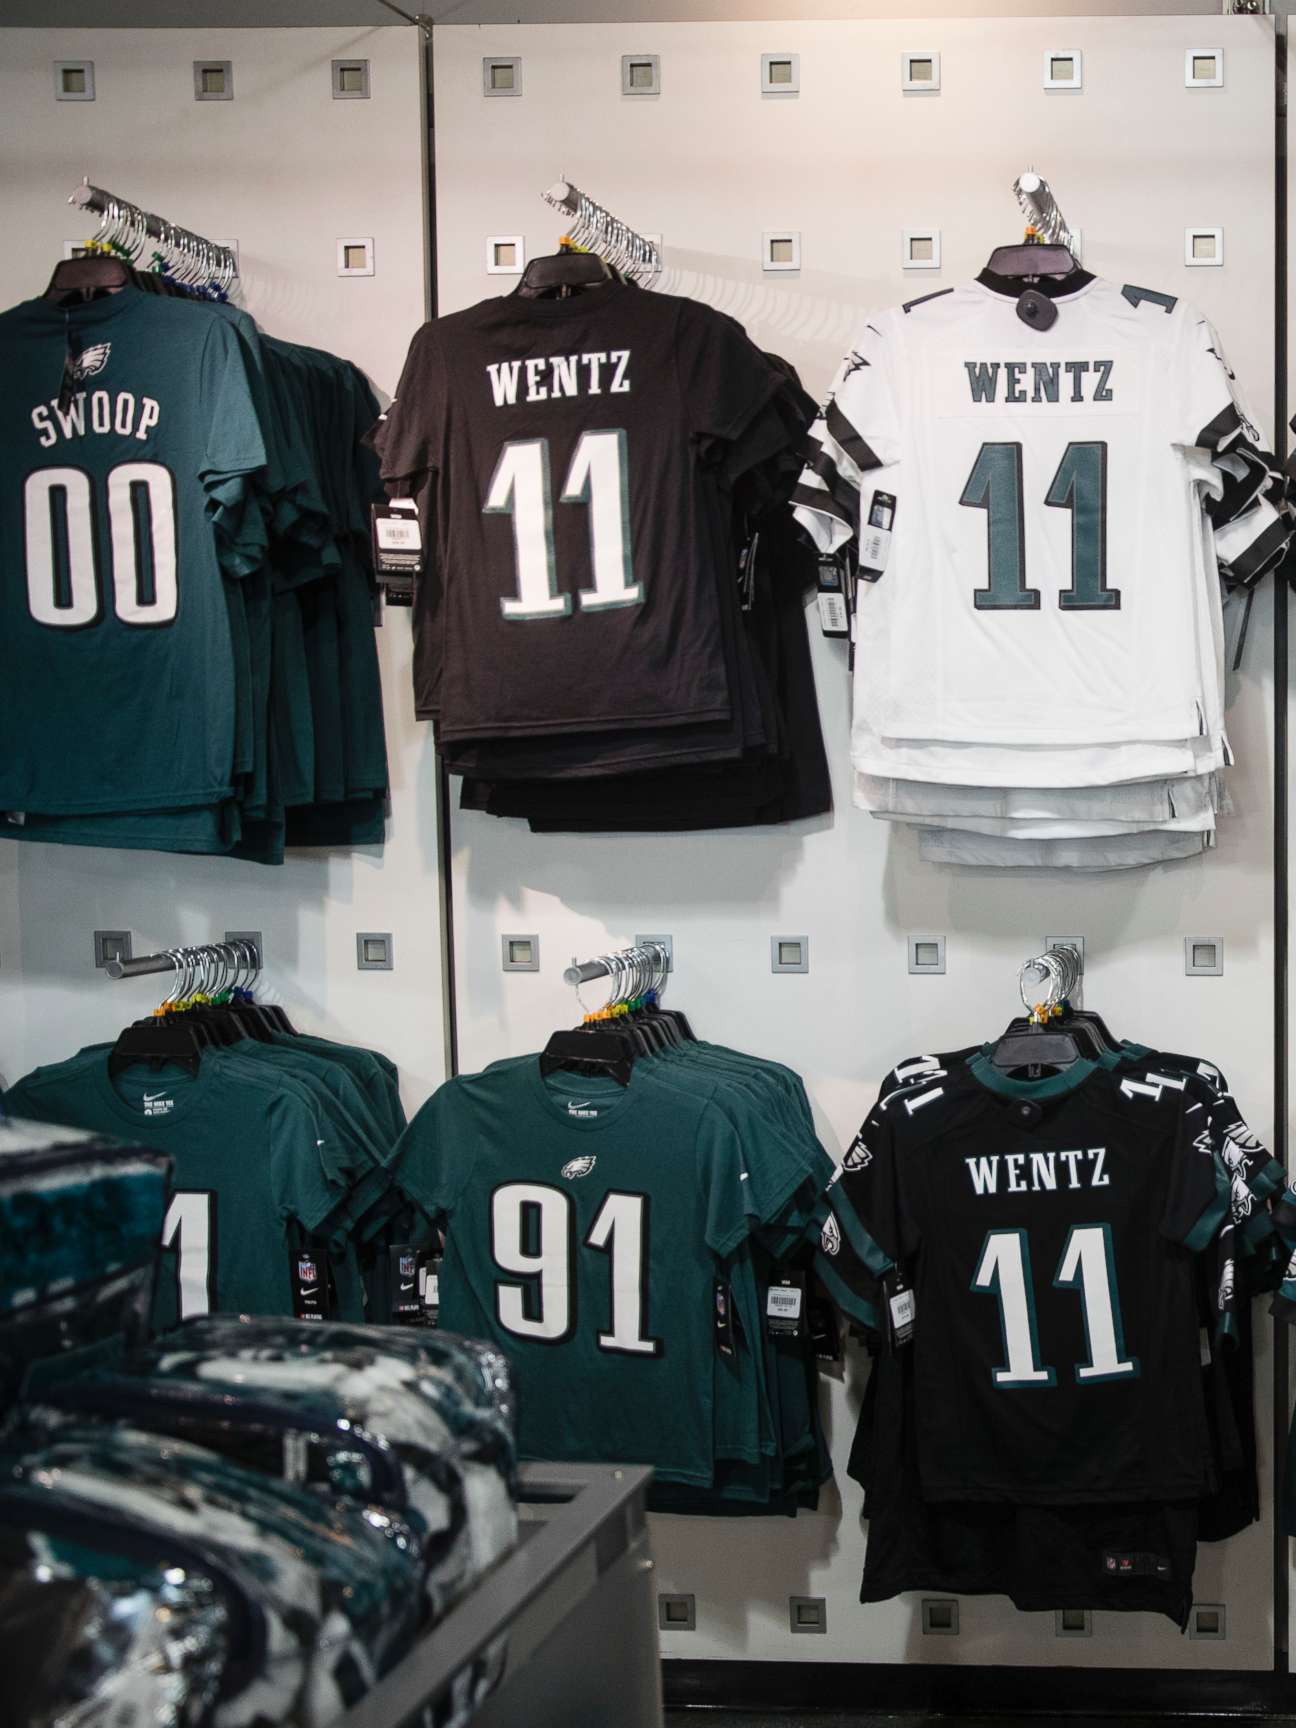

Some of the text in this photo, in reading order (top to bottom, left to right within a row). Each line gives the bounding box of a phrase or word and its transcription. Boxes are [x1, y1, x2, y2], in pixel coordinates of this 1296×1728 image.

[31, 390, 161, 448] SWOOP
[486, 349, 632, 407] WENTZ
[964, 359, 1115, 404] WENTZ
[23, 461, 178, 631] 00
[482, 428, 645, 622] 11
[958, 440, 1121, 611] 11
[965, 1147, 1110, 1196] WENTZ
[160, 1190, 216, 1320] 1
[488, 1180, 664, 1359] 91
[969, 1221, 1141, 1390] 11
